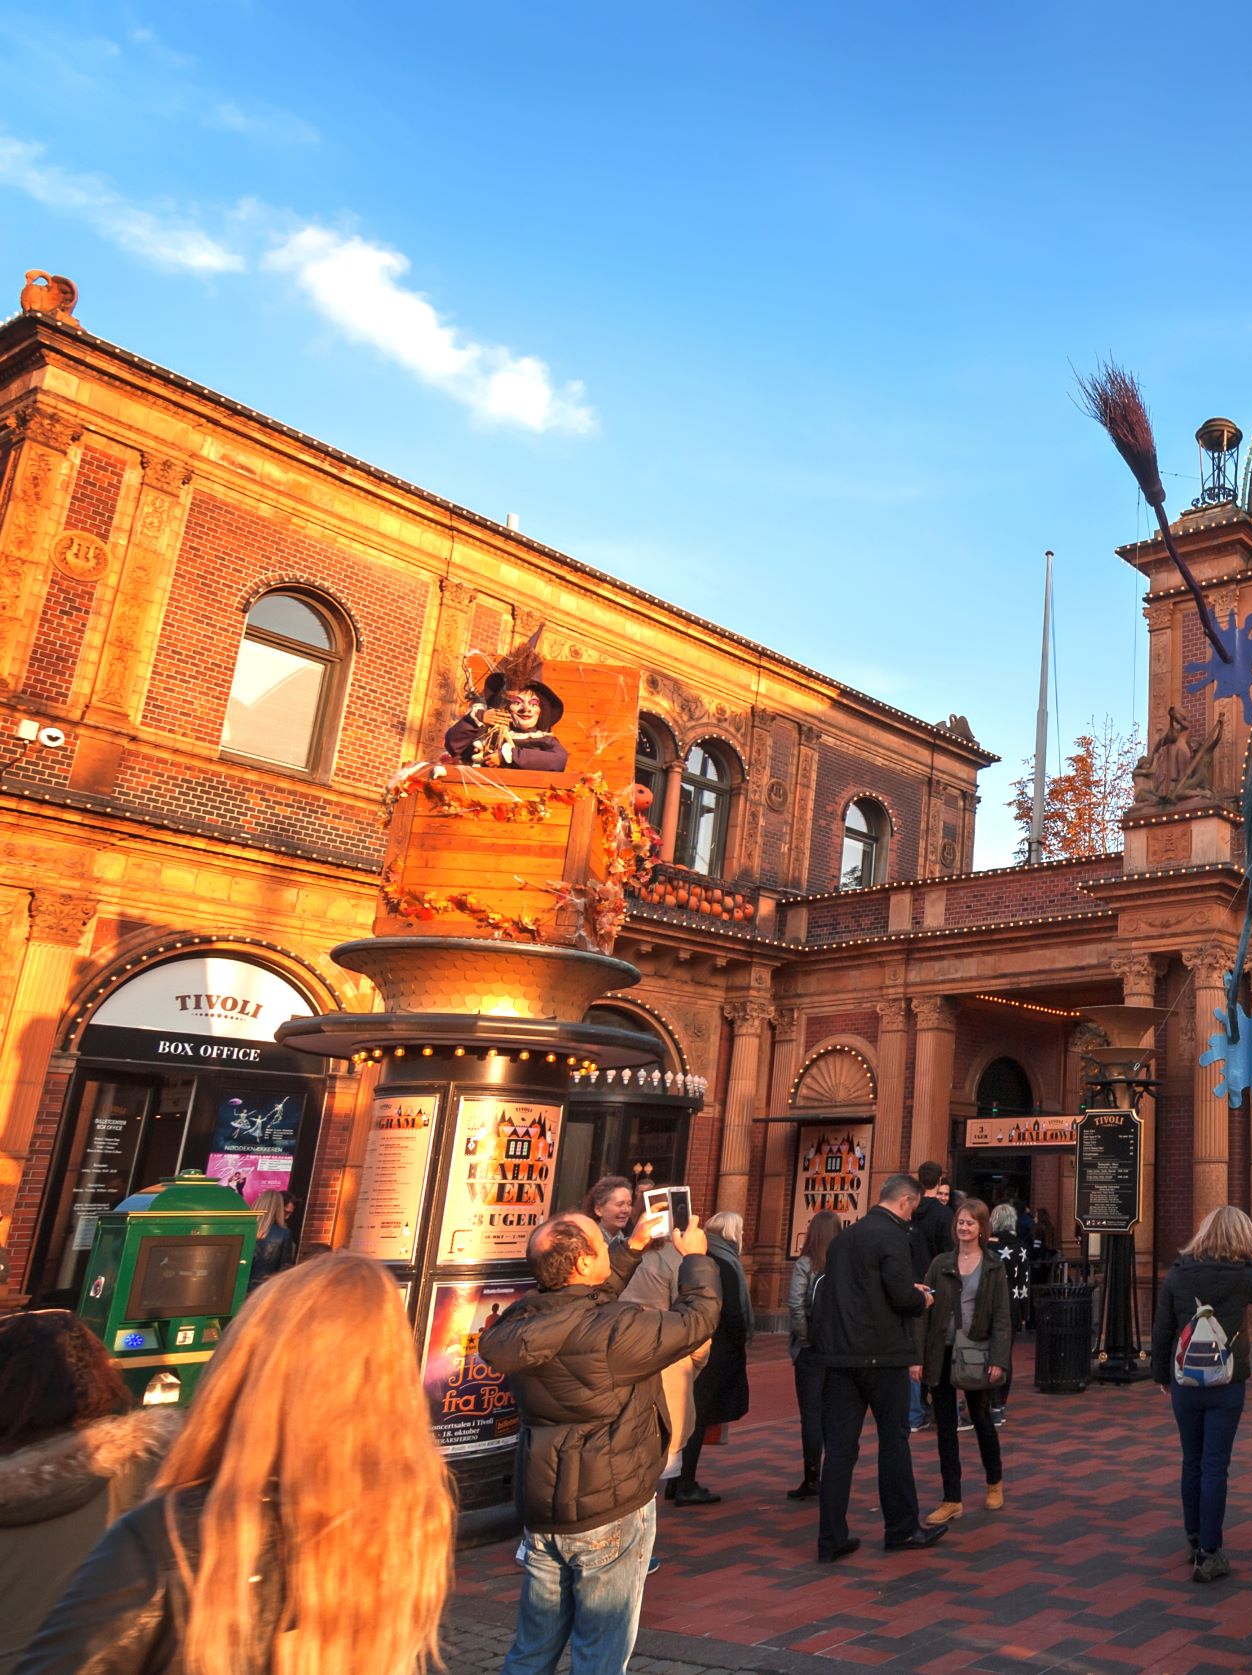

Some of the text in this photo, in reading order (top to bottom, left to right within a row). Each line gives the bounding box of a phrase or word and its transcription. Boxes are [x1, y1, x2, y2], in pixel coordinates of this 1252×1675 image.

[175, 994, 263, 1019] TIVOLI
[158, 1041, 261, 1061] BOX OFFICE
[1094, 1116, 1124, 1126] TIVOLI
[1017, 1130, 1077, 1141] HALLOWE
[467, 1163, 549, 1182] HALLO
[805, 1176, 861, 1191] HALLO
[467, 1182, 548, 1203] WEEN
[804, 1193, 861, 1210] WEEN
[473, 1214, 538, 1227] 3 UGER
[442, 1389, 477, 1413] fra
[432, 1420, 471, 1431] oncertsalen
[477, 1418, 494, 1426] Tivoli
[454, 1428, 480, 1436] oktober
